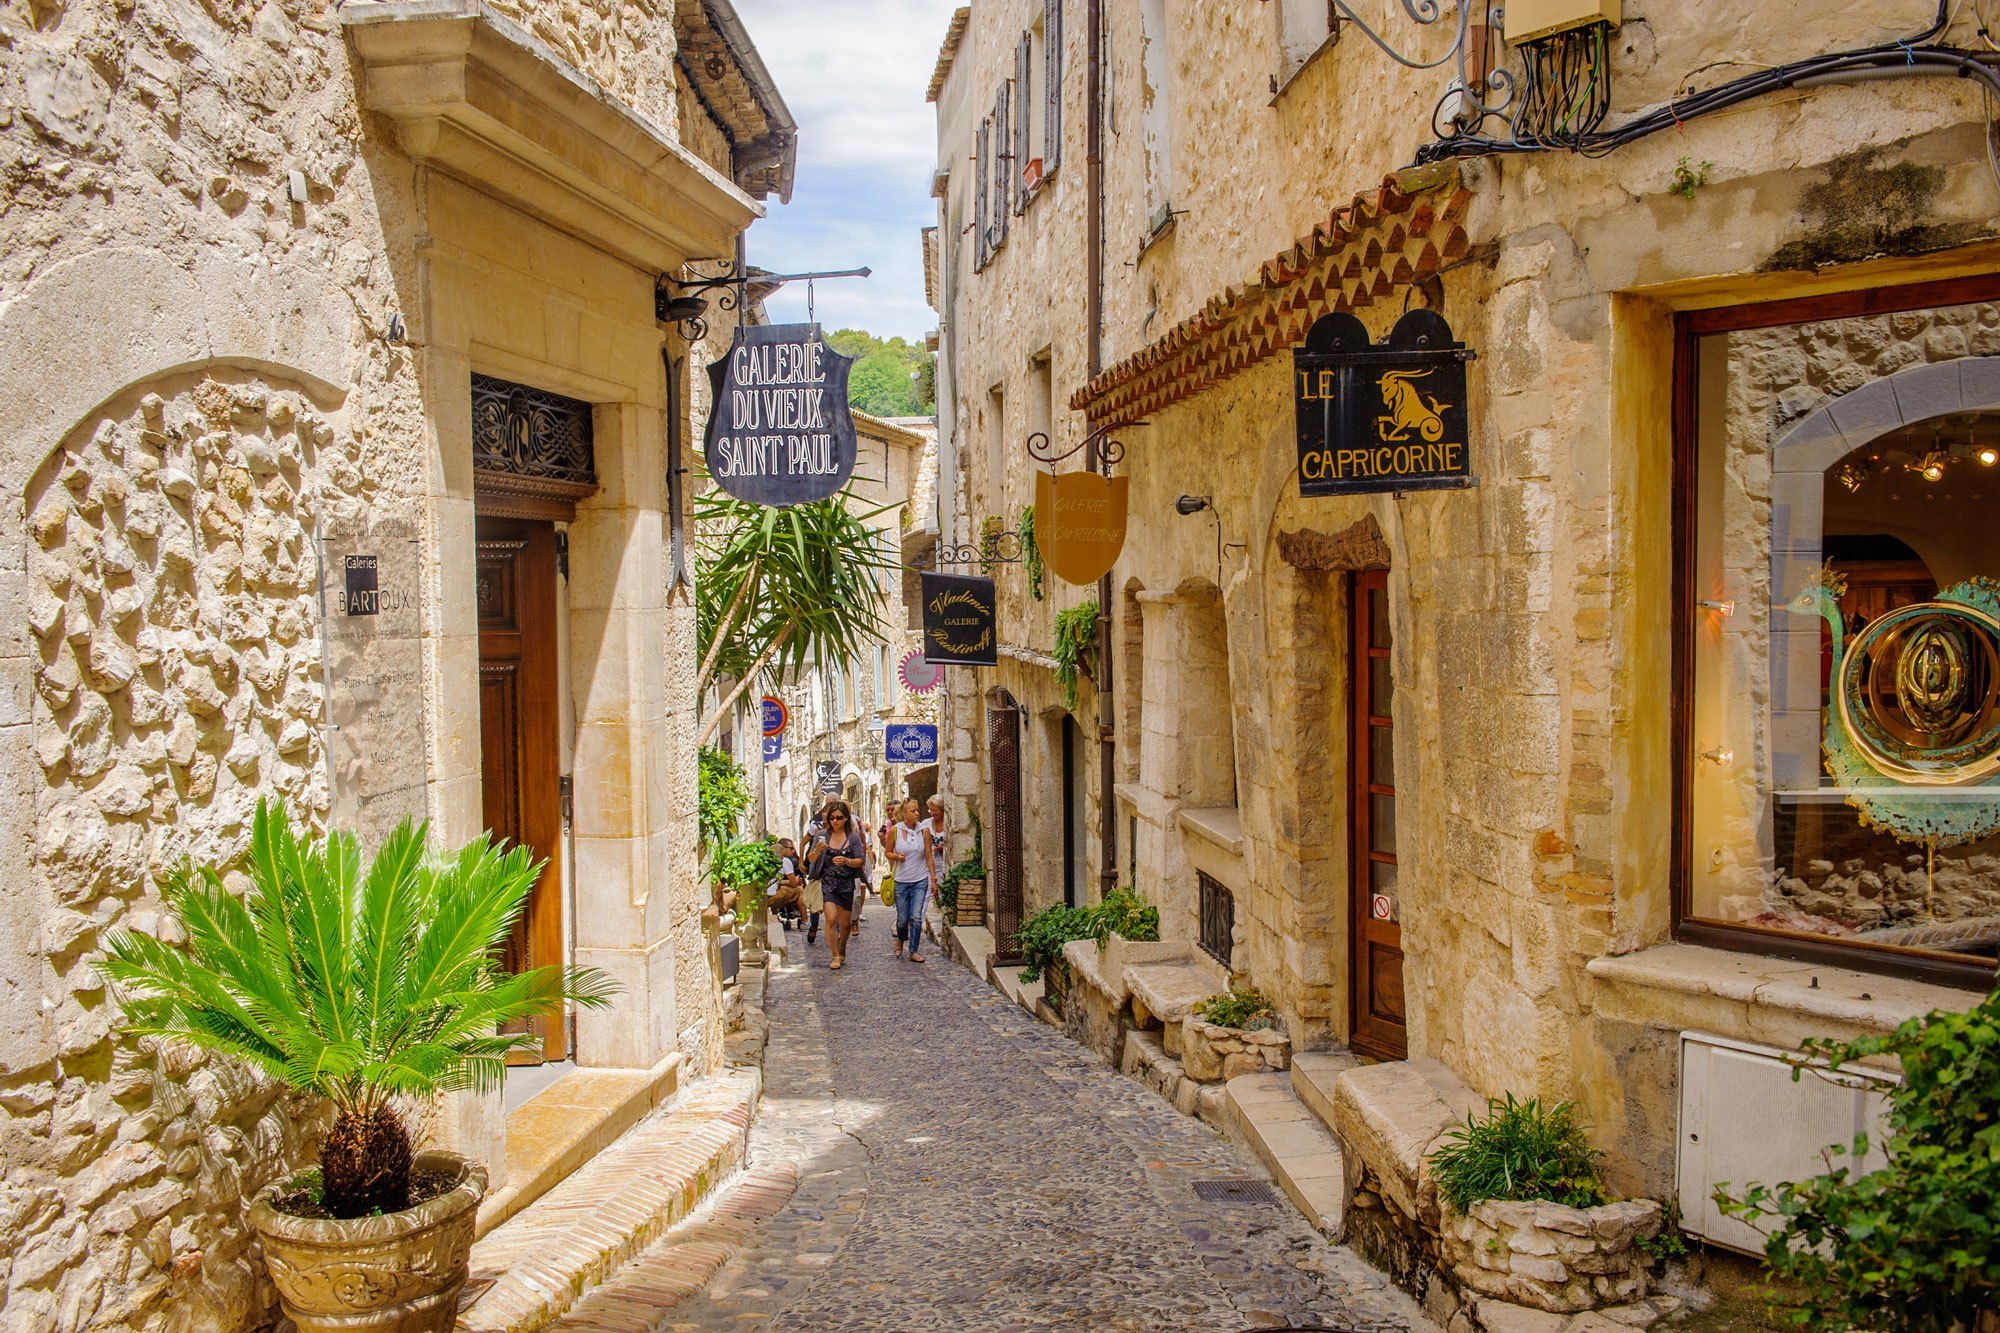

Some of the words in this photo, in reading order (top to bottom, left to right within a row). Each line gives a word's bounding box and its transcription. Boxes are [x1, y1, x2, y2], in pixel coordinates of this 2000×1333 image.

[733, 341, 826, 386] GALERIE
[1301, 370, 1335, 400] LE
[732, 389, 760, 431] DU
[763, 388, 824, 430] VIEUX
[717, 435, 784, 477] SAINT
[787, 434, 839, 475] PAUL
[1301, 443, 1463, 480] CAPRICORNE
[1053, 495, 1108, 513] GALERIE
[346, 556, 377, 569] Galeries
[339, 589, 410, 612] BARTOUX
[929, 589, 991, 617] Vladimir
[943, 617, 980, 626] GALERIE
[903, 740, 919, 749] MB
